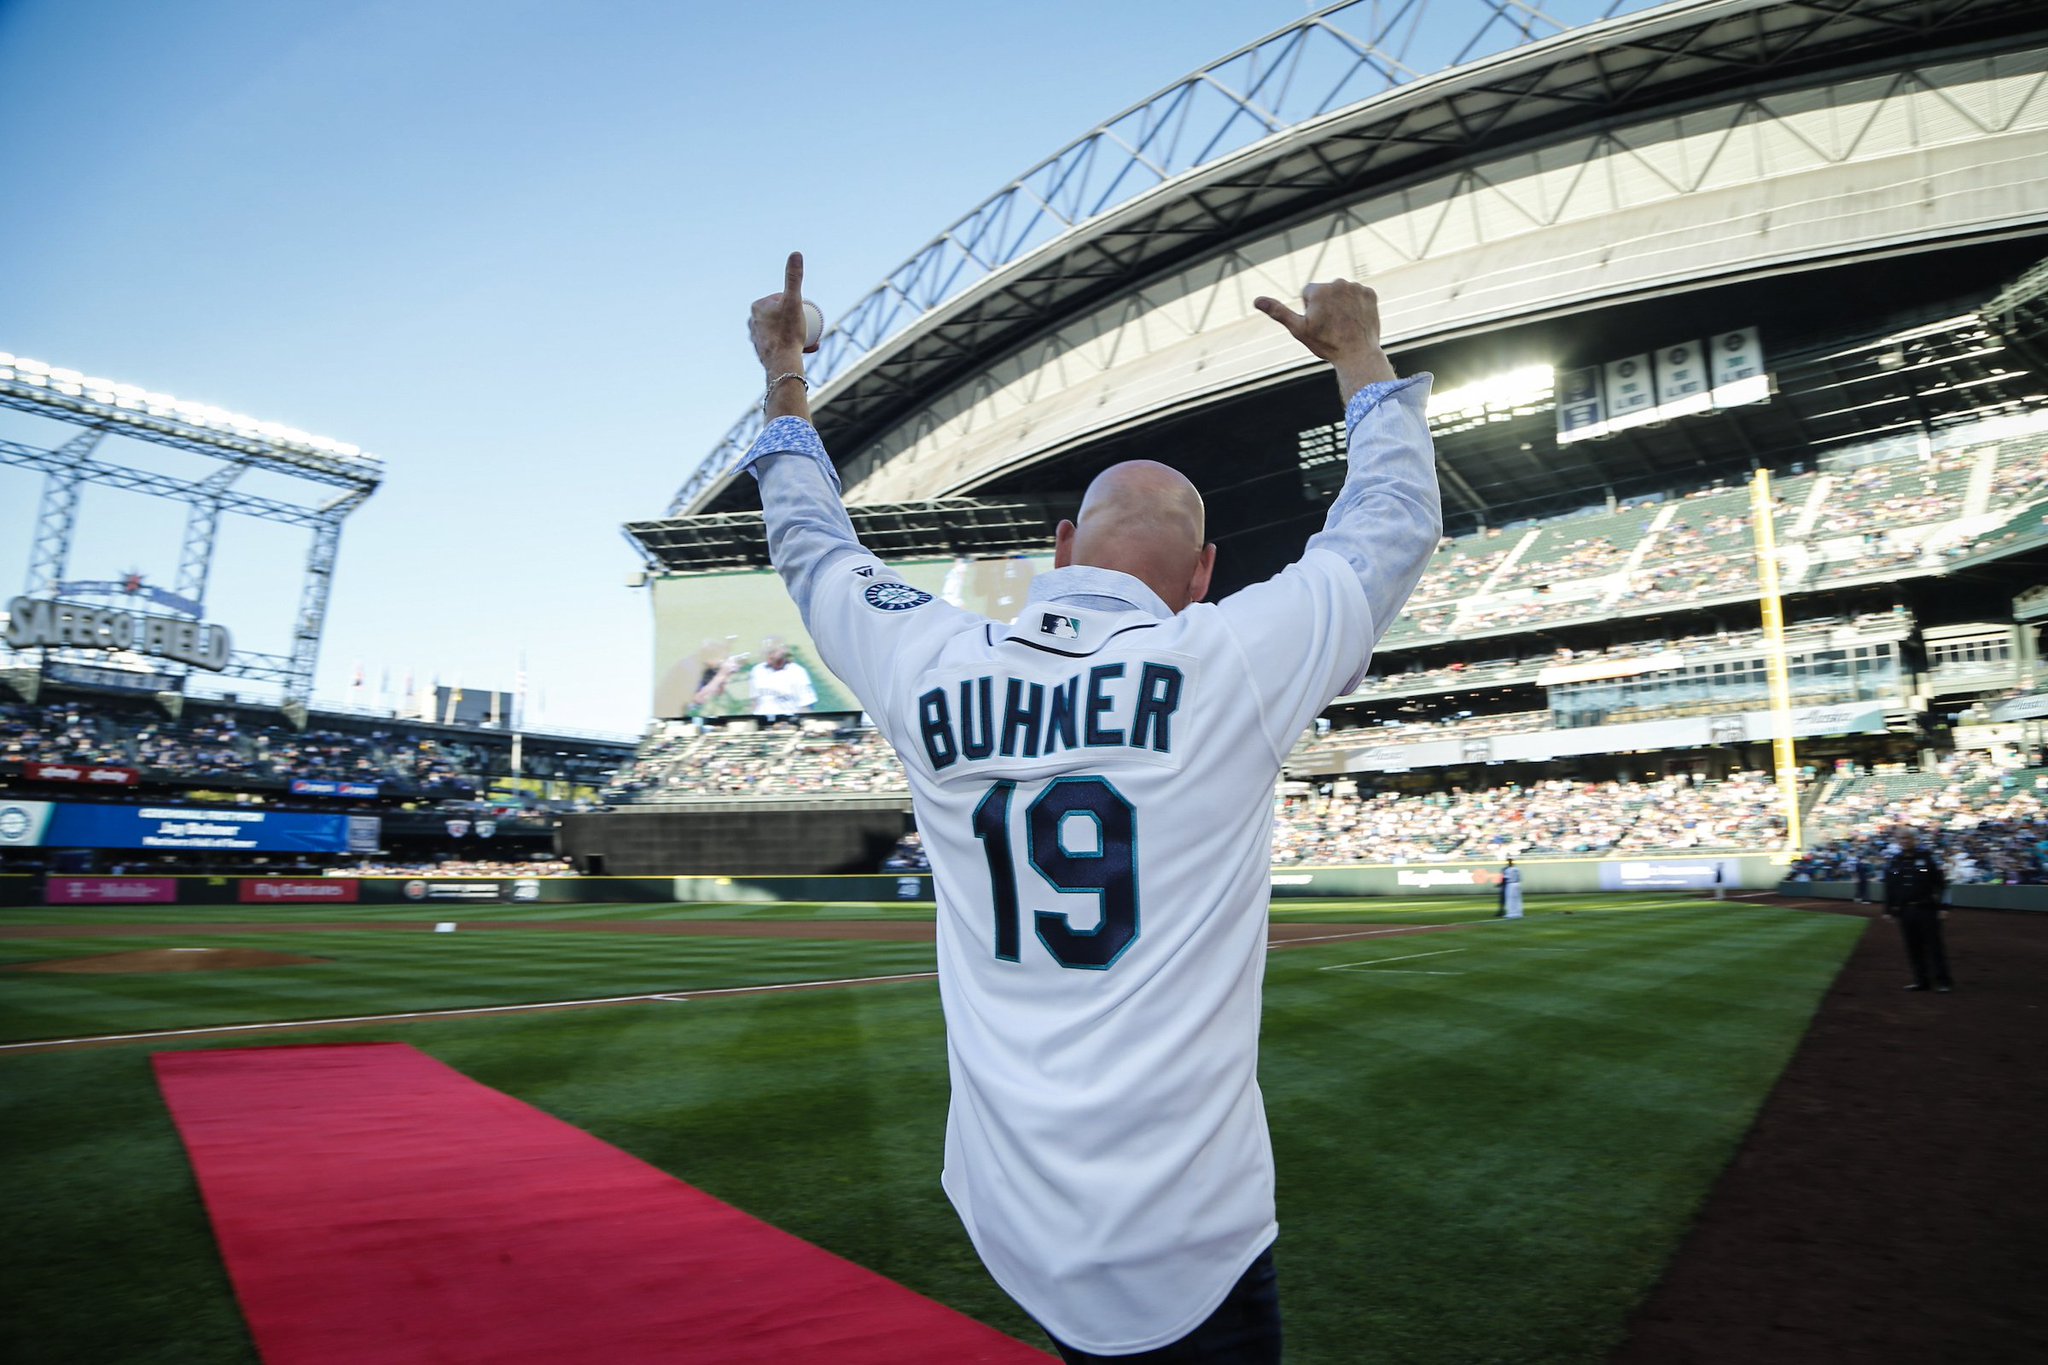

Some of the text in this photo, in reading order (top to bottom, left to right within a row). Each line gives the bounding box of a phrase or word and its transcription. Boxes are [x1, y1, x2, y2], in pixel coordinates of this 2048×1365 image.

[5, 596, 230, 672] SAFECO FIELD
[919, 661, 1184, 771] BUHNER
[254, 882, 344, 898] Fly Emirates
[972, 774, 1140, 971] 19
